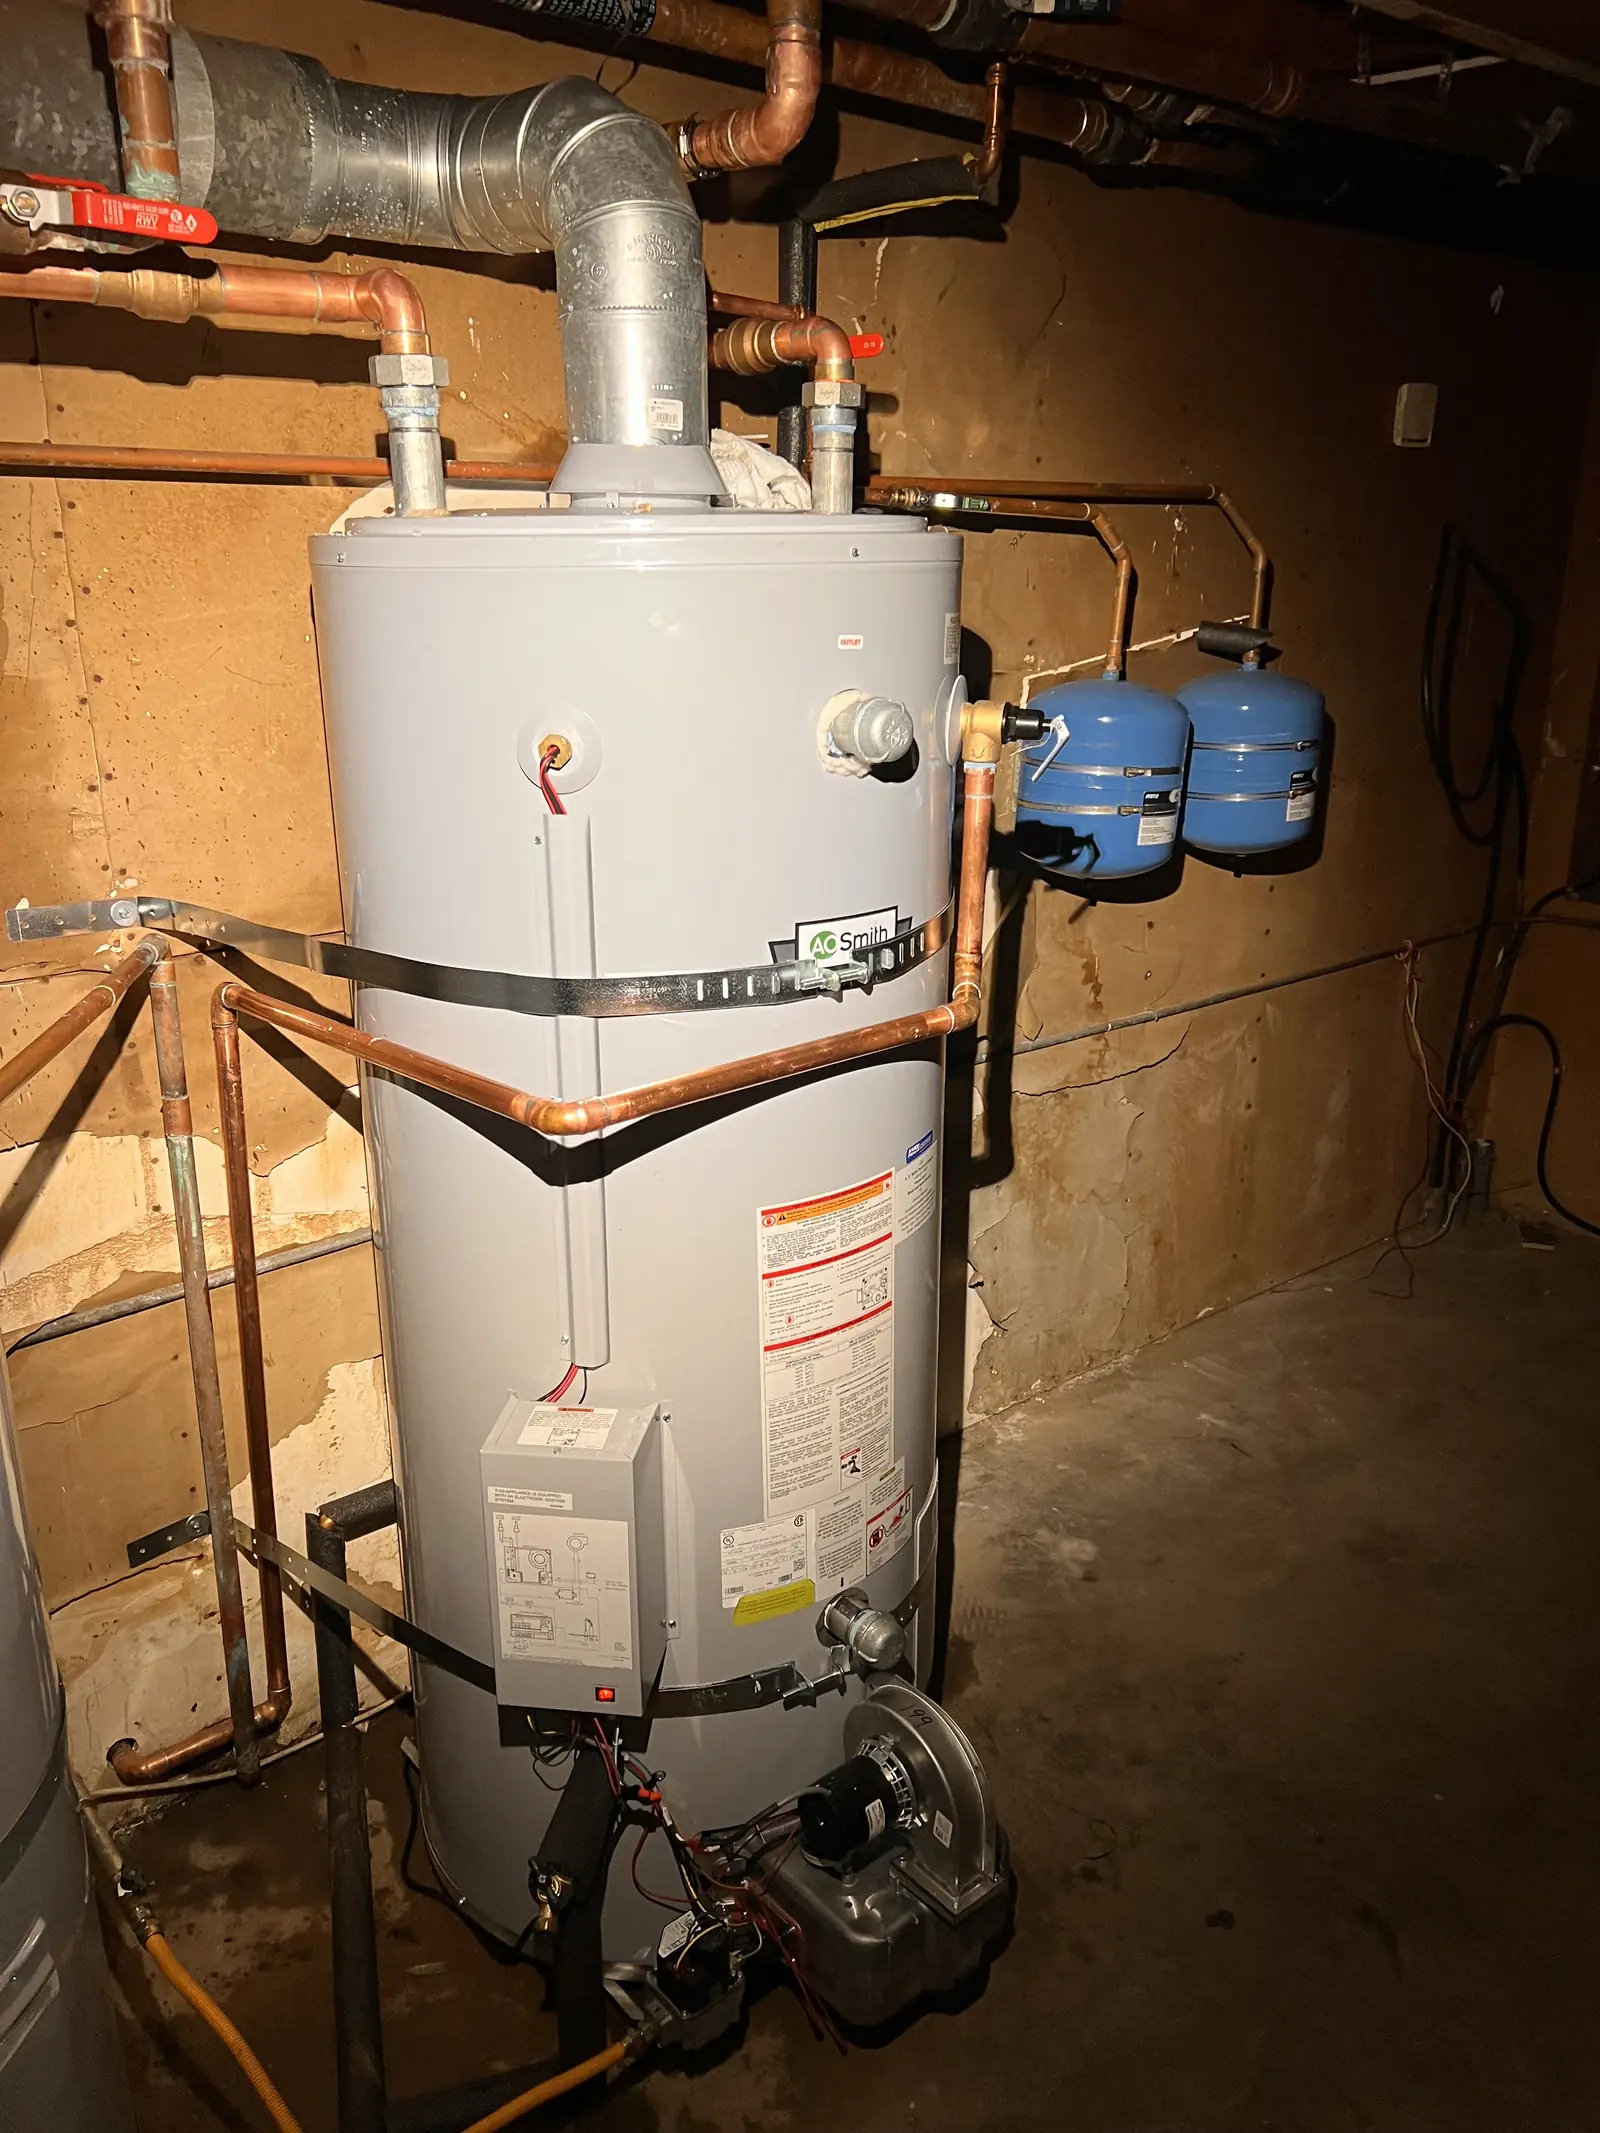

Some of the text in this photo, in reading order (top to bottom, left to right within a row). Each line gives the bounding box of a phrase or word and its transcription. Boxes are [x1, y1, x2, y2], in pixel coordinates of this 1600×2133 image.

[136, 213, 159, 228] RWV
[840, 638, 861, 646] OUTLET
[840, 925, 888, 951] Smith
[901, 1704, 933, 1728] 199
